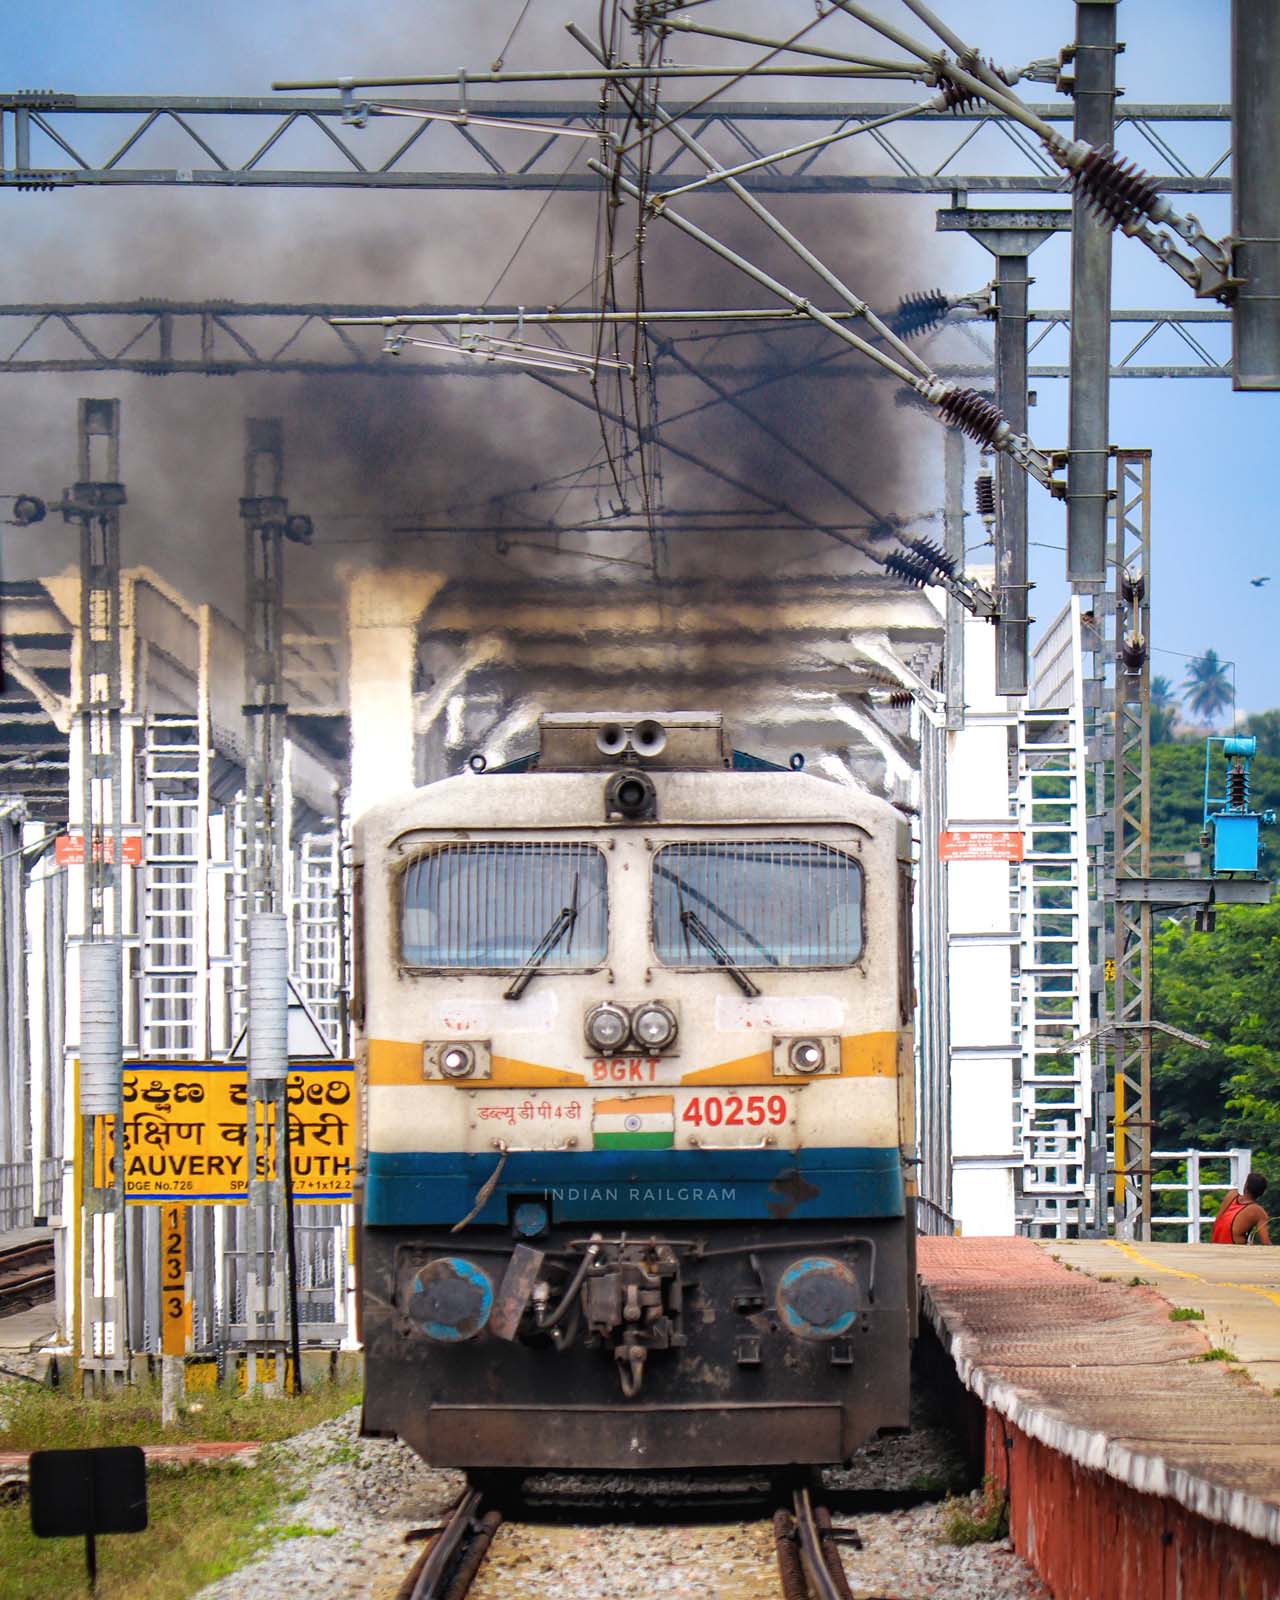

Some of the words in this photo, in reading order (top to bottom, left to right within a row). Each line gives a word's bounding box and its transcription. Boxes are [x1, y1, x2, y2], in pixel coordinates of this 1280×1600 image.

[592, 1058, 662, 1081] BGKT
[682, 1095, 787, 1126] 40259
[255, 1155, 350, 1176] SUTH
[168, 1297, 183, 1319] 3
